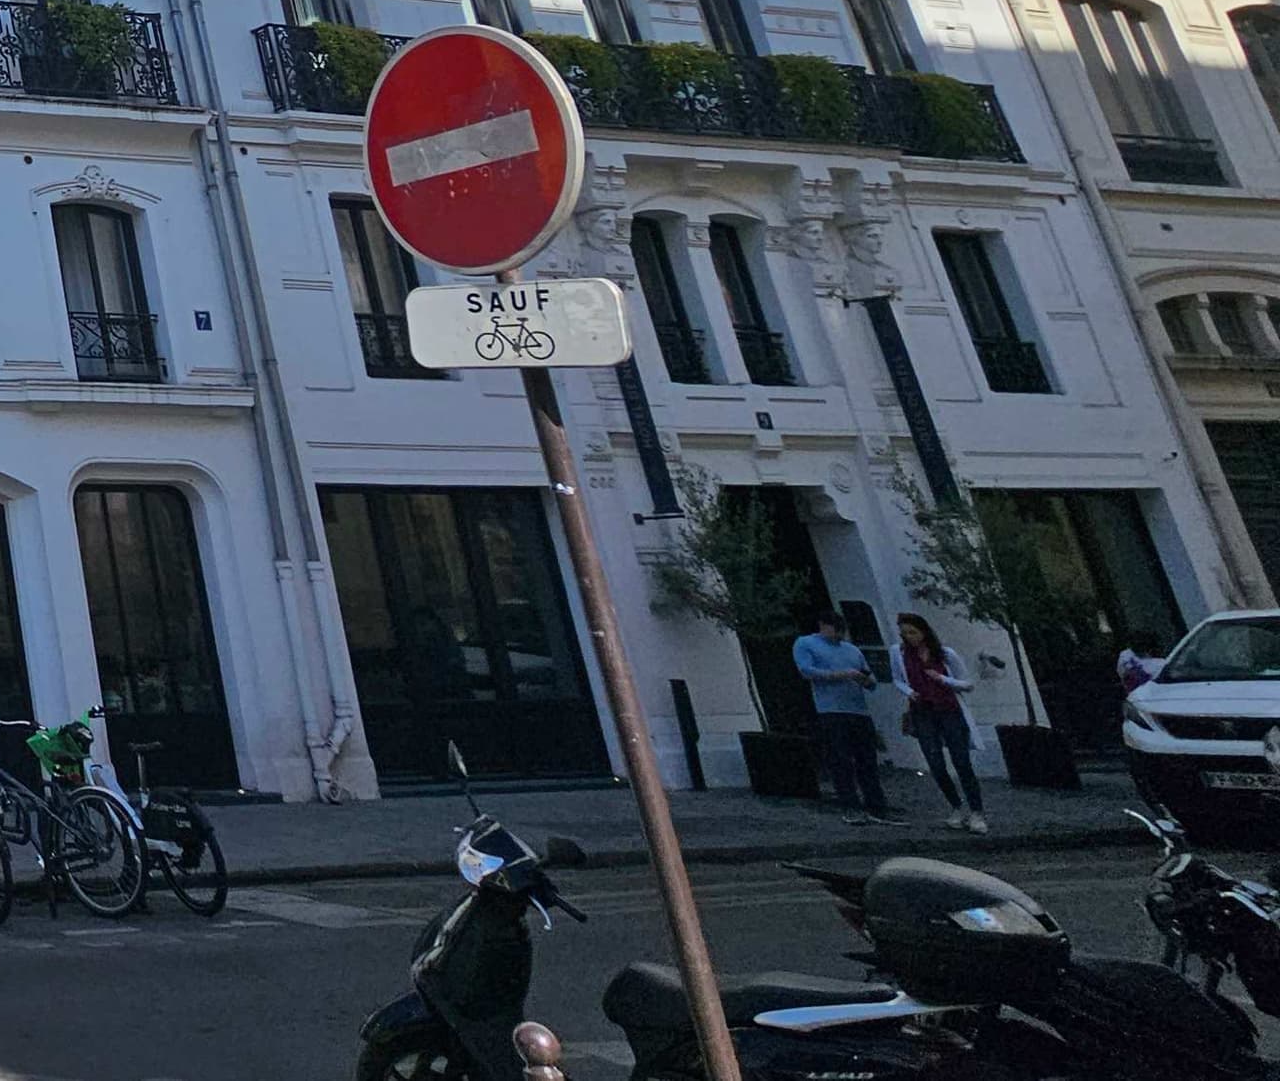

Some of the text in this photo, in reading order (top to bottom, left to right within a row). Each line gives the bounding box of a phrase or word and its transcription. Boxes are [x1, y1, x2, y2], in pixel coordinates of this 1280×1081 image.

[466, 289, 550, 314] SAUF
[197, 313, 207, 330] 7
[759, 413, 769, 427] 9
